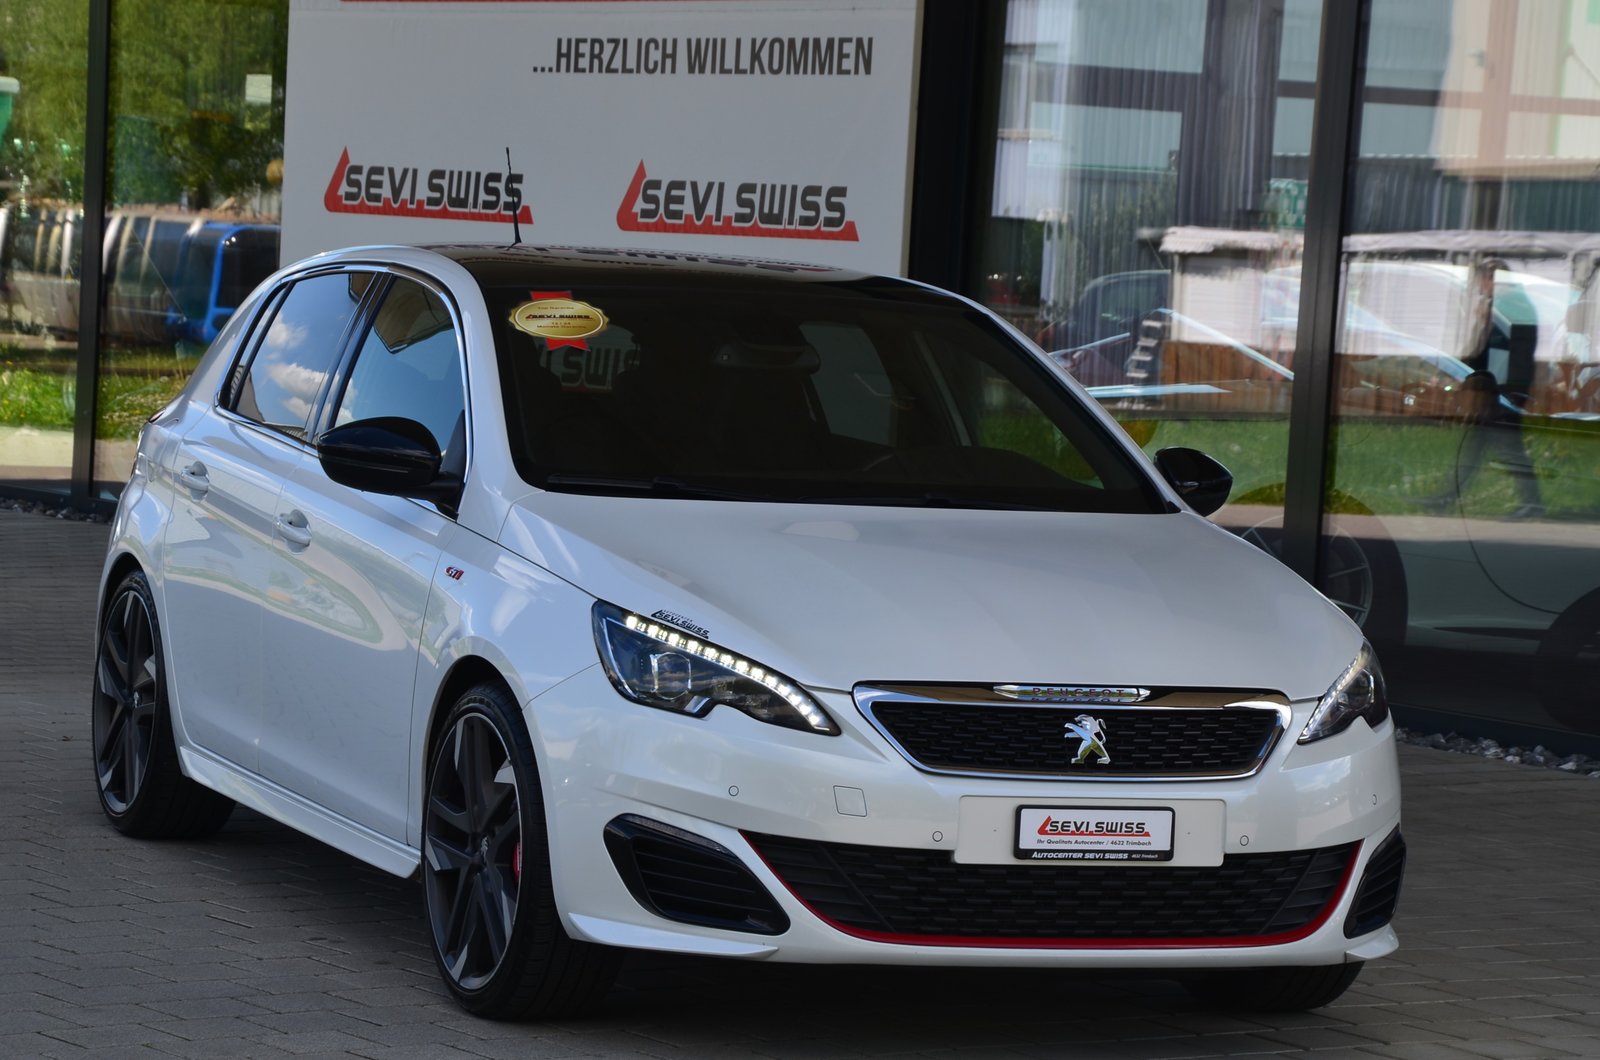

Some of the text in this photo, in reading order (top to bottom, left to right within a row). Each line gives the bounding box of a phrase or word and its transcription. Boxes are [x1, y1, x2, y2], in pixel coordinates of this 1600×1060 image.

[532, 36, 874, 76] ...HERZLICH WILLKOMMEN
[343, 164, 524, 213] SEVI SWISS
[638, 178, 849, 229] SEVI SWISS
[658, 611, 710, 637] SEVI SWISS
[1032, 687, 1125, 697] PEUGEOT
[1049, 821, 1145, 834] SEVI SWISS
[1074, 838, 1105, 846] Autocenter
[1126, 839, 1152, 847] Trimbach
[1084, 852, 1103, 860] SEVI
[1104, 852, 1129, 860] SWISS
